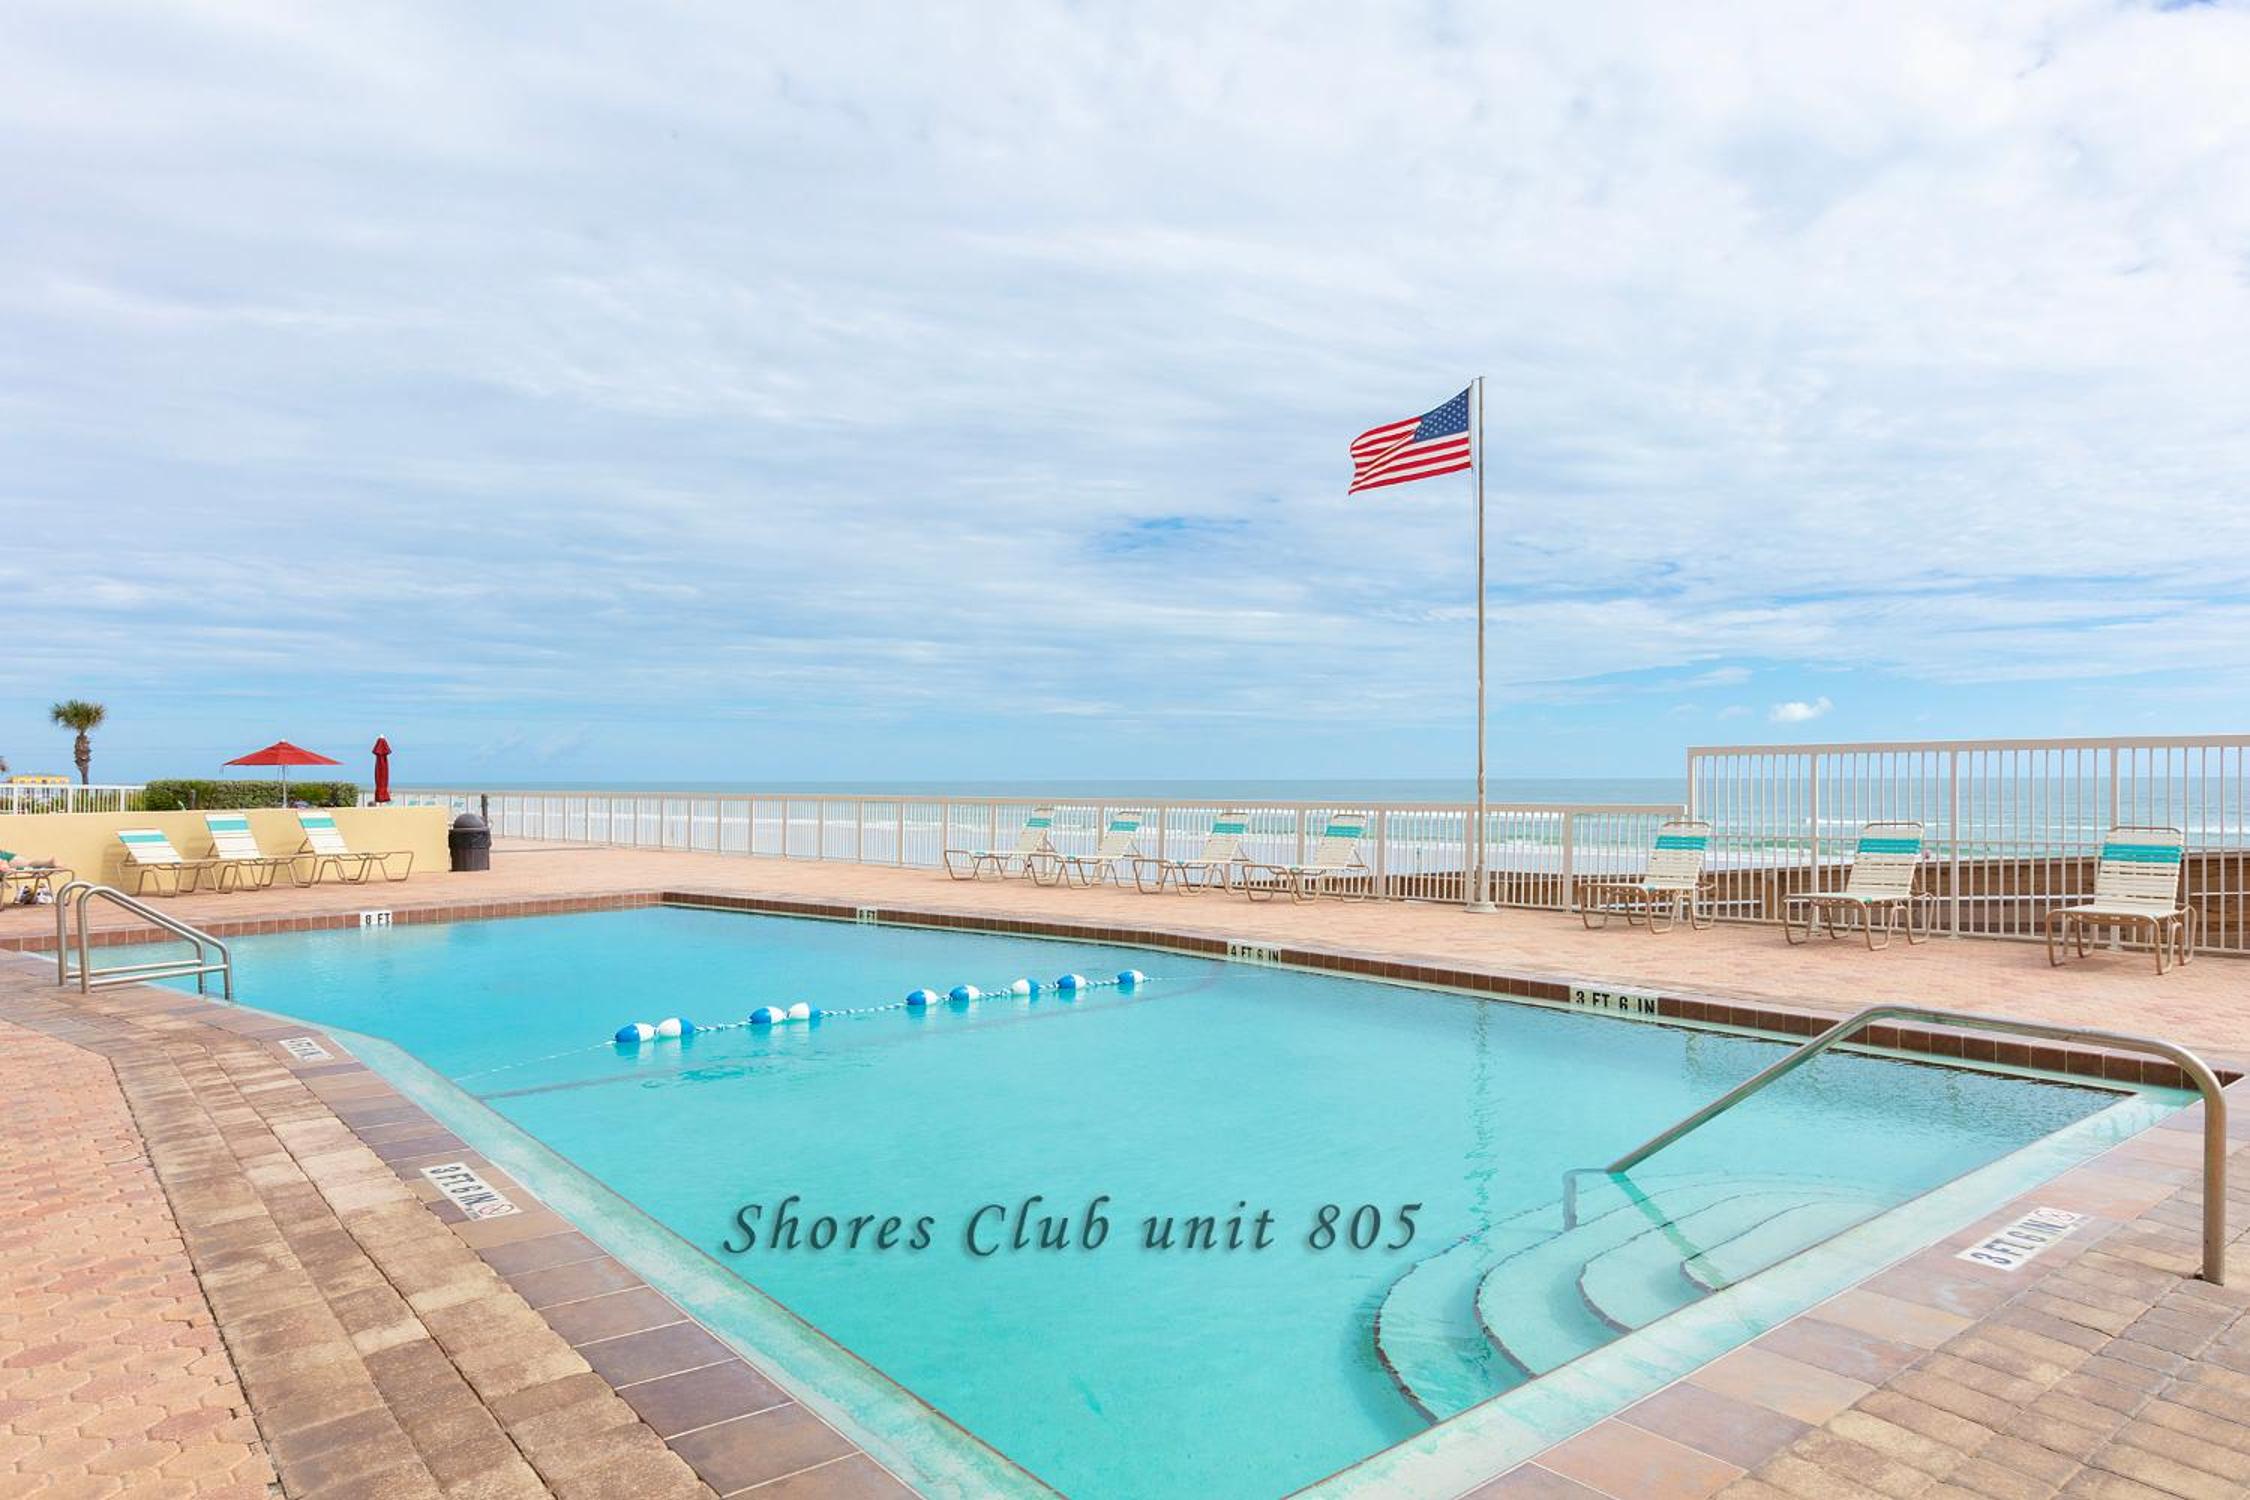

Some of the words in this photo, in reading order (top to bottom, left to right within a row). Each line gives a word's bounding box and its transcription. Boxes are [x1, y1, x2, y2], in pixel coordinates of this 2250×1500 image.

[377, 913, 390, 927] FT
[1241, 946, 1252, 958] FT
[1268, 949, 1279, 962] IN
[1576, 991, 1585, 1004] 3
[1592, 993, 1610, 1007] FT
[1620, 996, 1628, 1010] 6
[1638, 998, 1655, 1014] IN
[435, 1173, 475, 1187] FT
[457, 1192, 499, 1205] IN
[2018, 1219, 2067, 1236] IN
[1983, 1238, 2035, 1256] FT
[1970, 1252, 2012, 1265] 3
